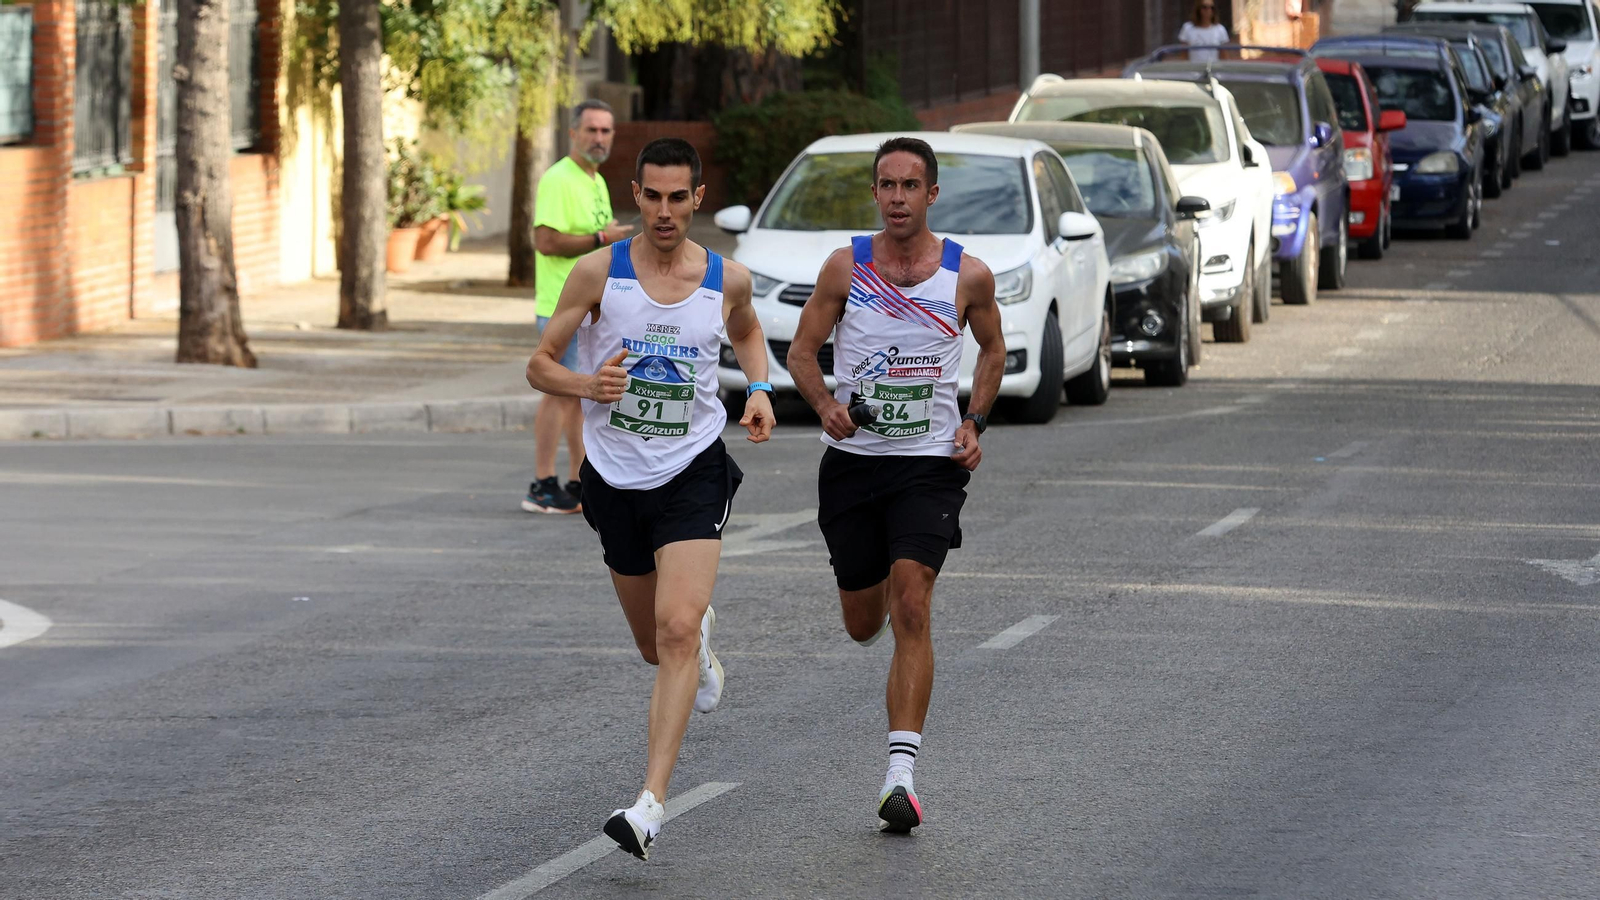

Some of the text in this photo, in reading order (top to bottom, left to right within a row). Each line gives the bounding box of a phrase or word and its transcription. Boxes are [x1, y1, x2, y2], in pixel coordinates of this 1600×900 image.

[646, 323, 680, 334] XEREZ
[622, 338, 699, 358] RUNNERS
[851, 357, 871, 378] Jerez
[637, 399, 664, 420] 91
[882, 403, 909, 421] 84
